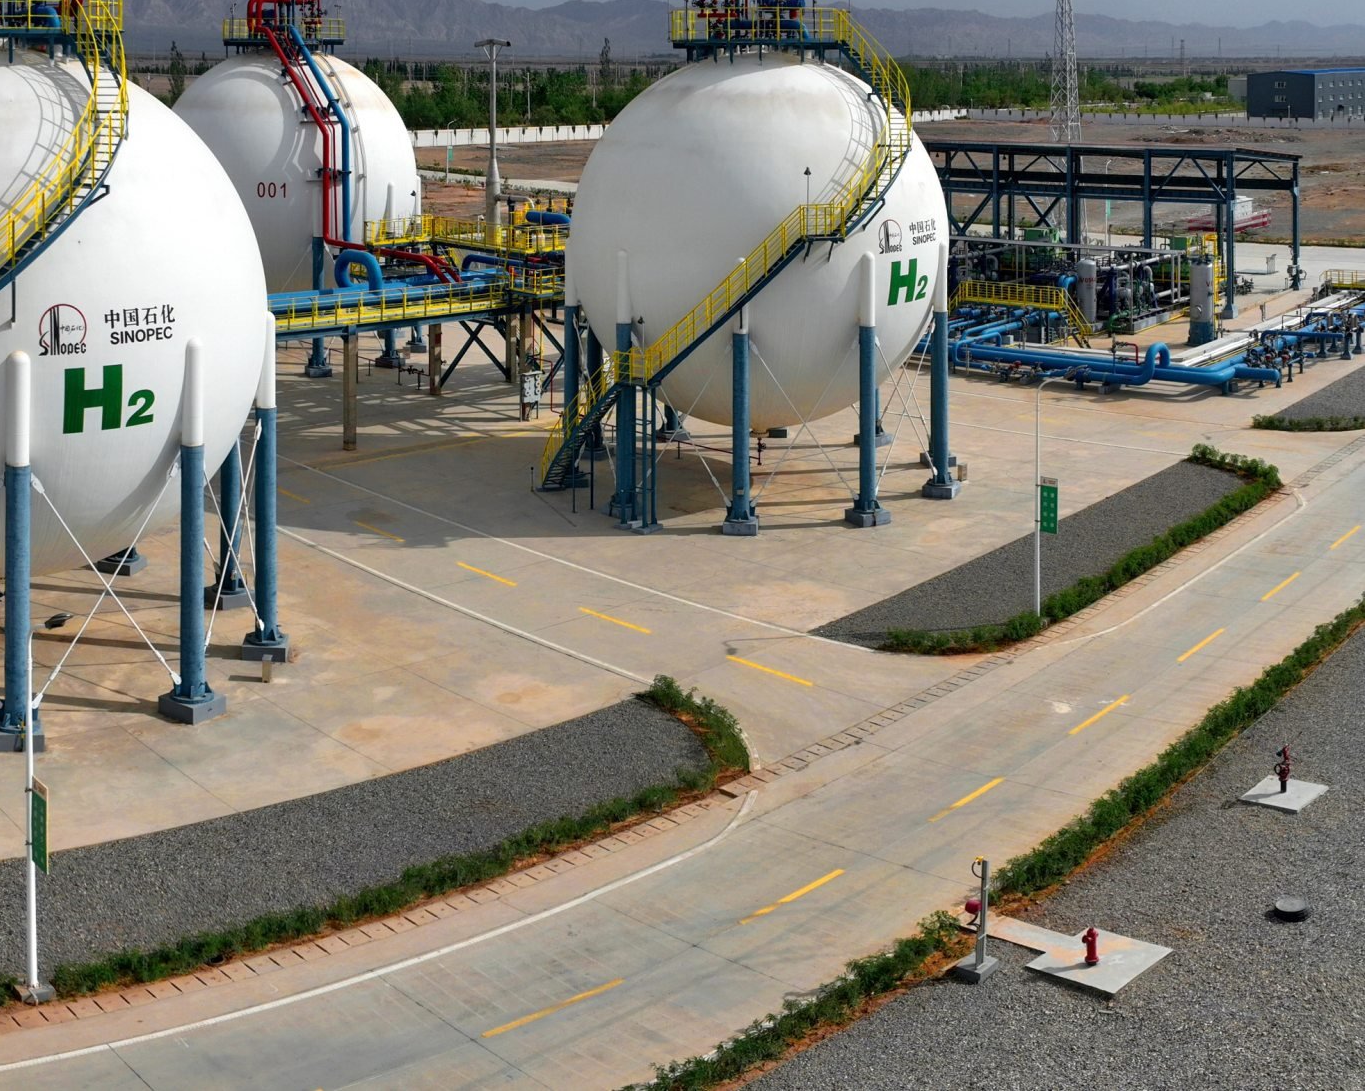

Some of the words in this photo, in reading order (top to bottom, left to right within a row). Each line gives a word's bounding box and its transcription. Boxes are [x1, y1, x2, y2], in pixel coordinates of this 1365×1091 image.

[257, 181, 286, 198] 001
[909, 218, 937, 235] 中国石化
[912, 232, 937, 246] SINOPEC
[887, 258, 929, 306] H2
[104, 304, 176, 329] 中国石化
[110, 326, 173, 345] SINOPEC
[62, 363, 155, 434] H2
